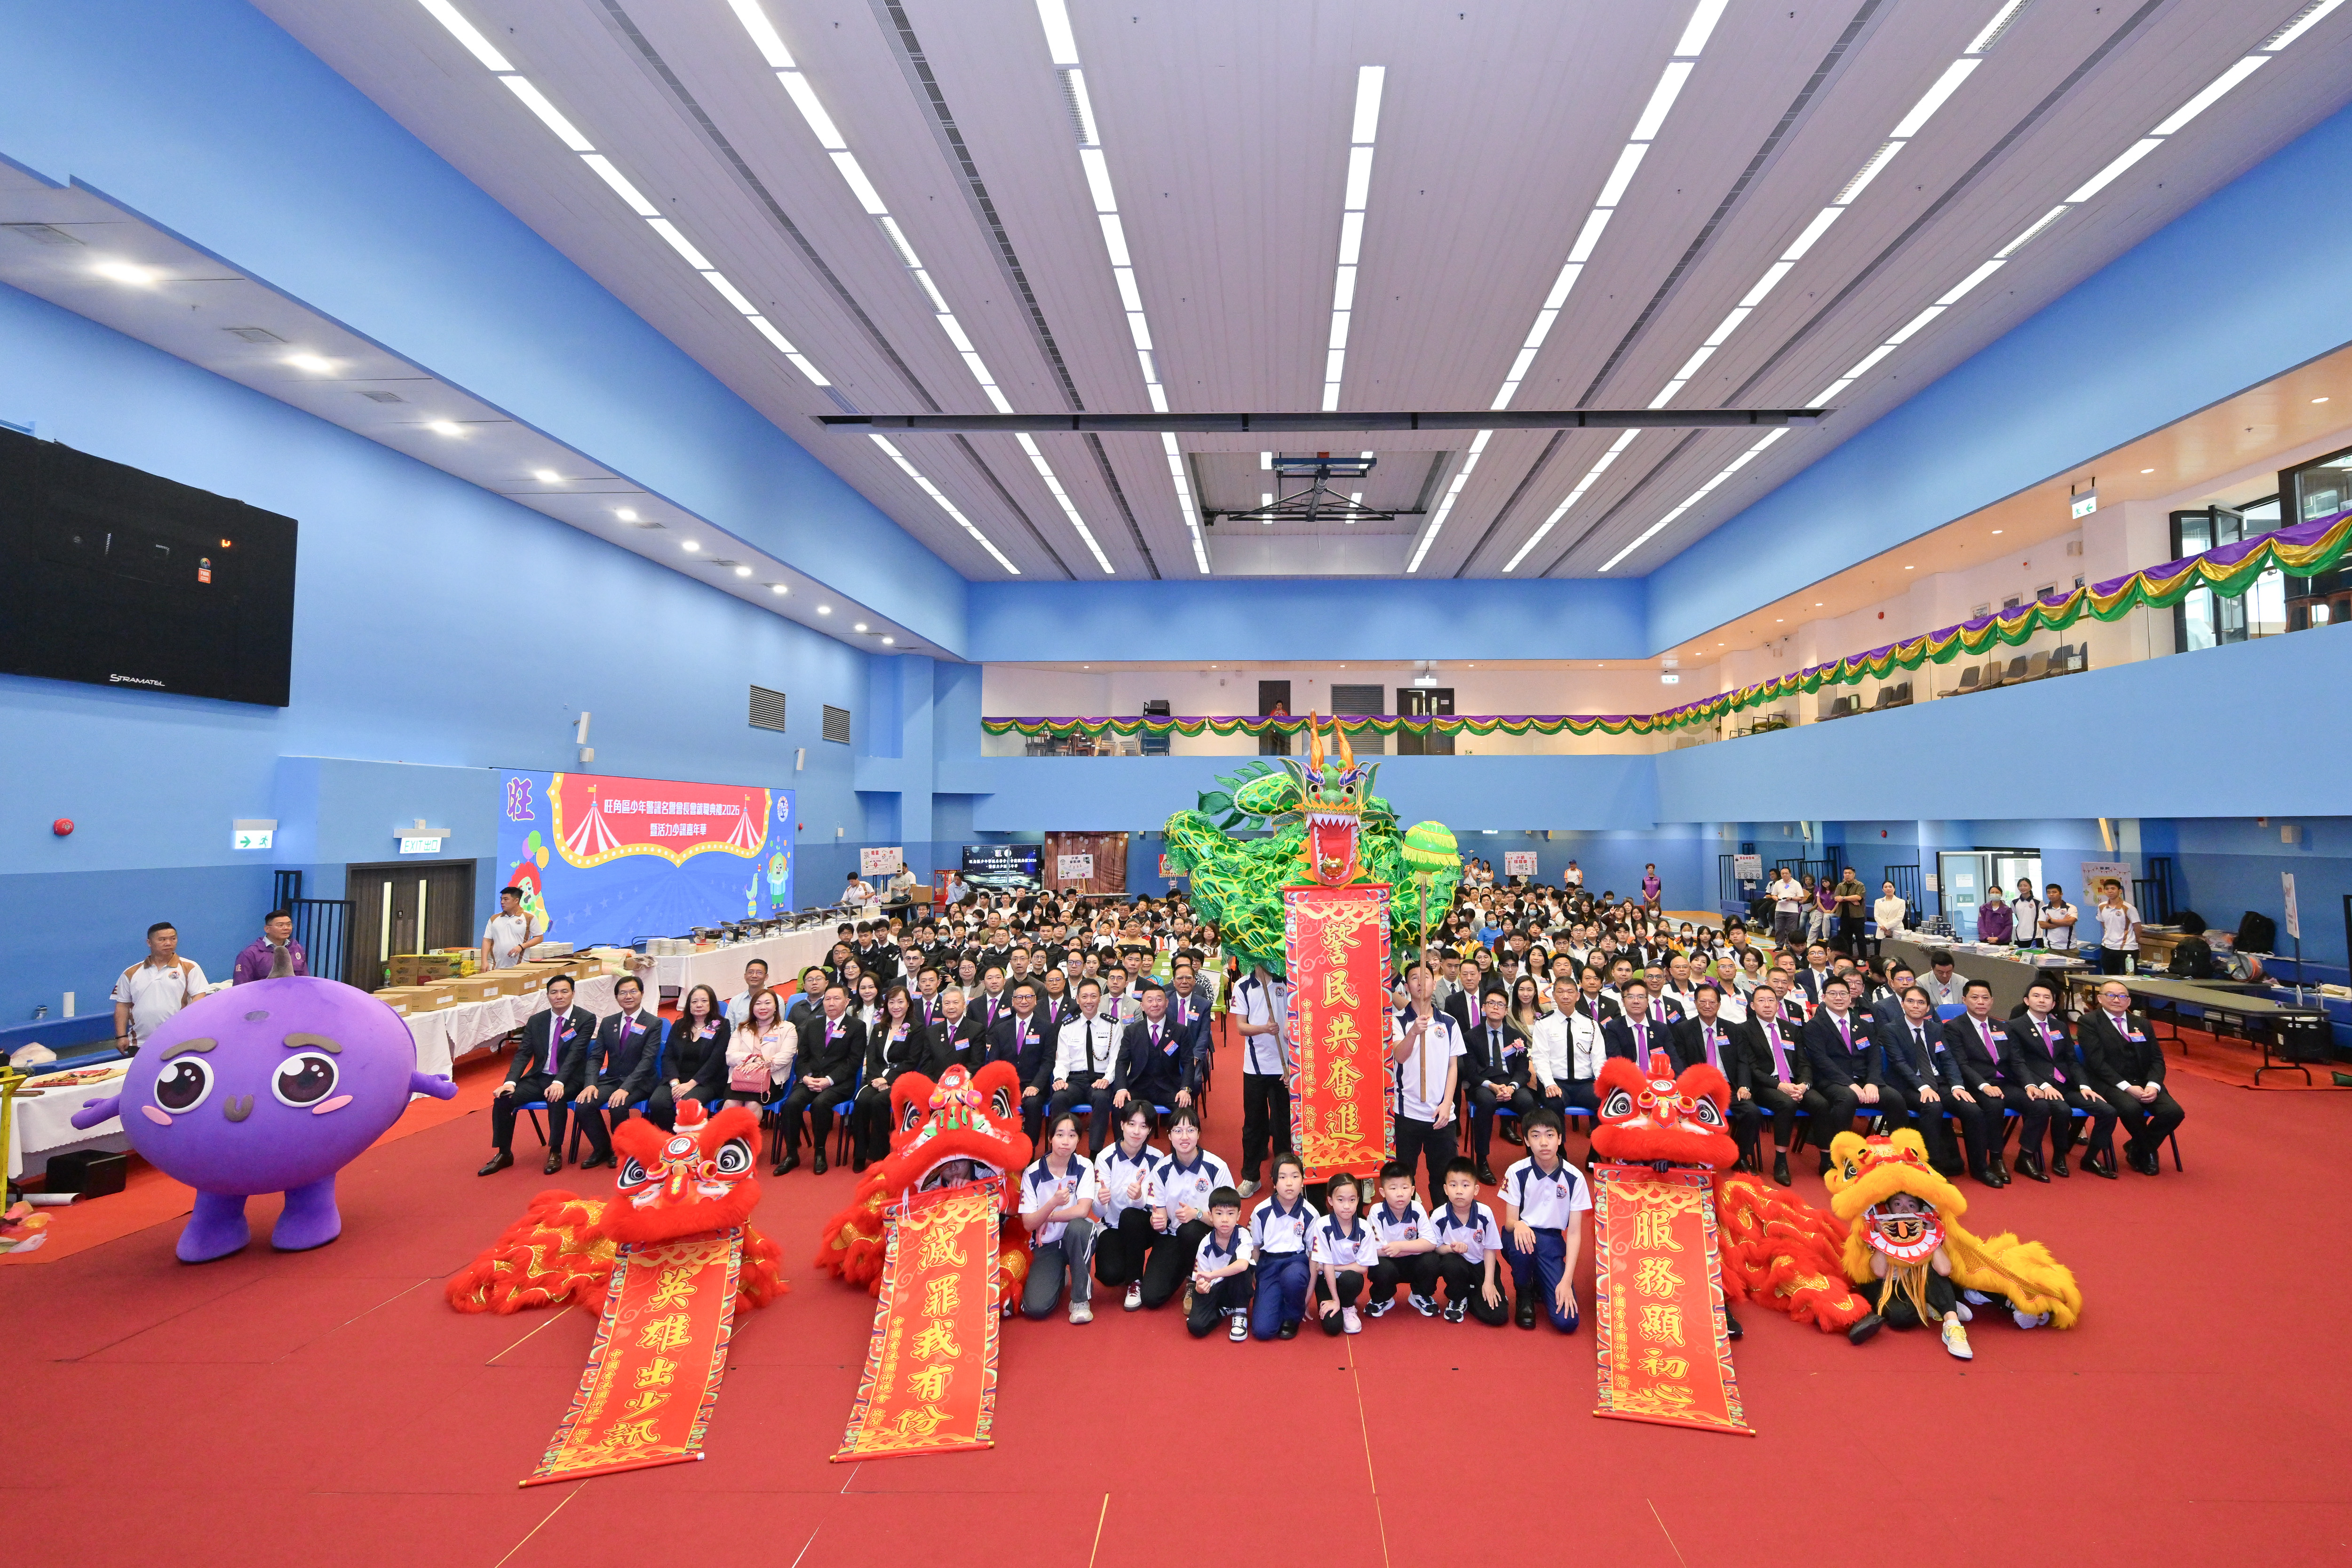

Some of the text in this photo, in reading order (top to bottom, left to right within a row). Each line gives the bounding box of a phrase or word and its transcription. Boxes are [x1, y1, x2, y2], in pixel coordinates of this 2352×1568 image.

[110, 674, 165, 686] STRAMATEL
[506, 777, 535, 822] 旺
[650, 823, 707, 836] 暨活力少訊嘉年華
[405, 840, 438, 852] EXIT 出口
[1301, 998, 1317, 1130] 中國香港國術總會 敬賀
[1321, 922, 1365, 1143] 警民共奮進
[894, 1224, 967, 1434] 滅罪我有份
[1613, 1283, 1630, 1371] 中國香港國術總會
[1632, 1209, 1695, 1405] 服務顯初心
[600, 1266, 698, 1447] 英雄出少訊
[874, 1316, 905, 1403] 中國香港國術總會
